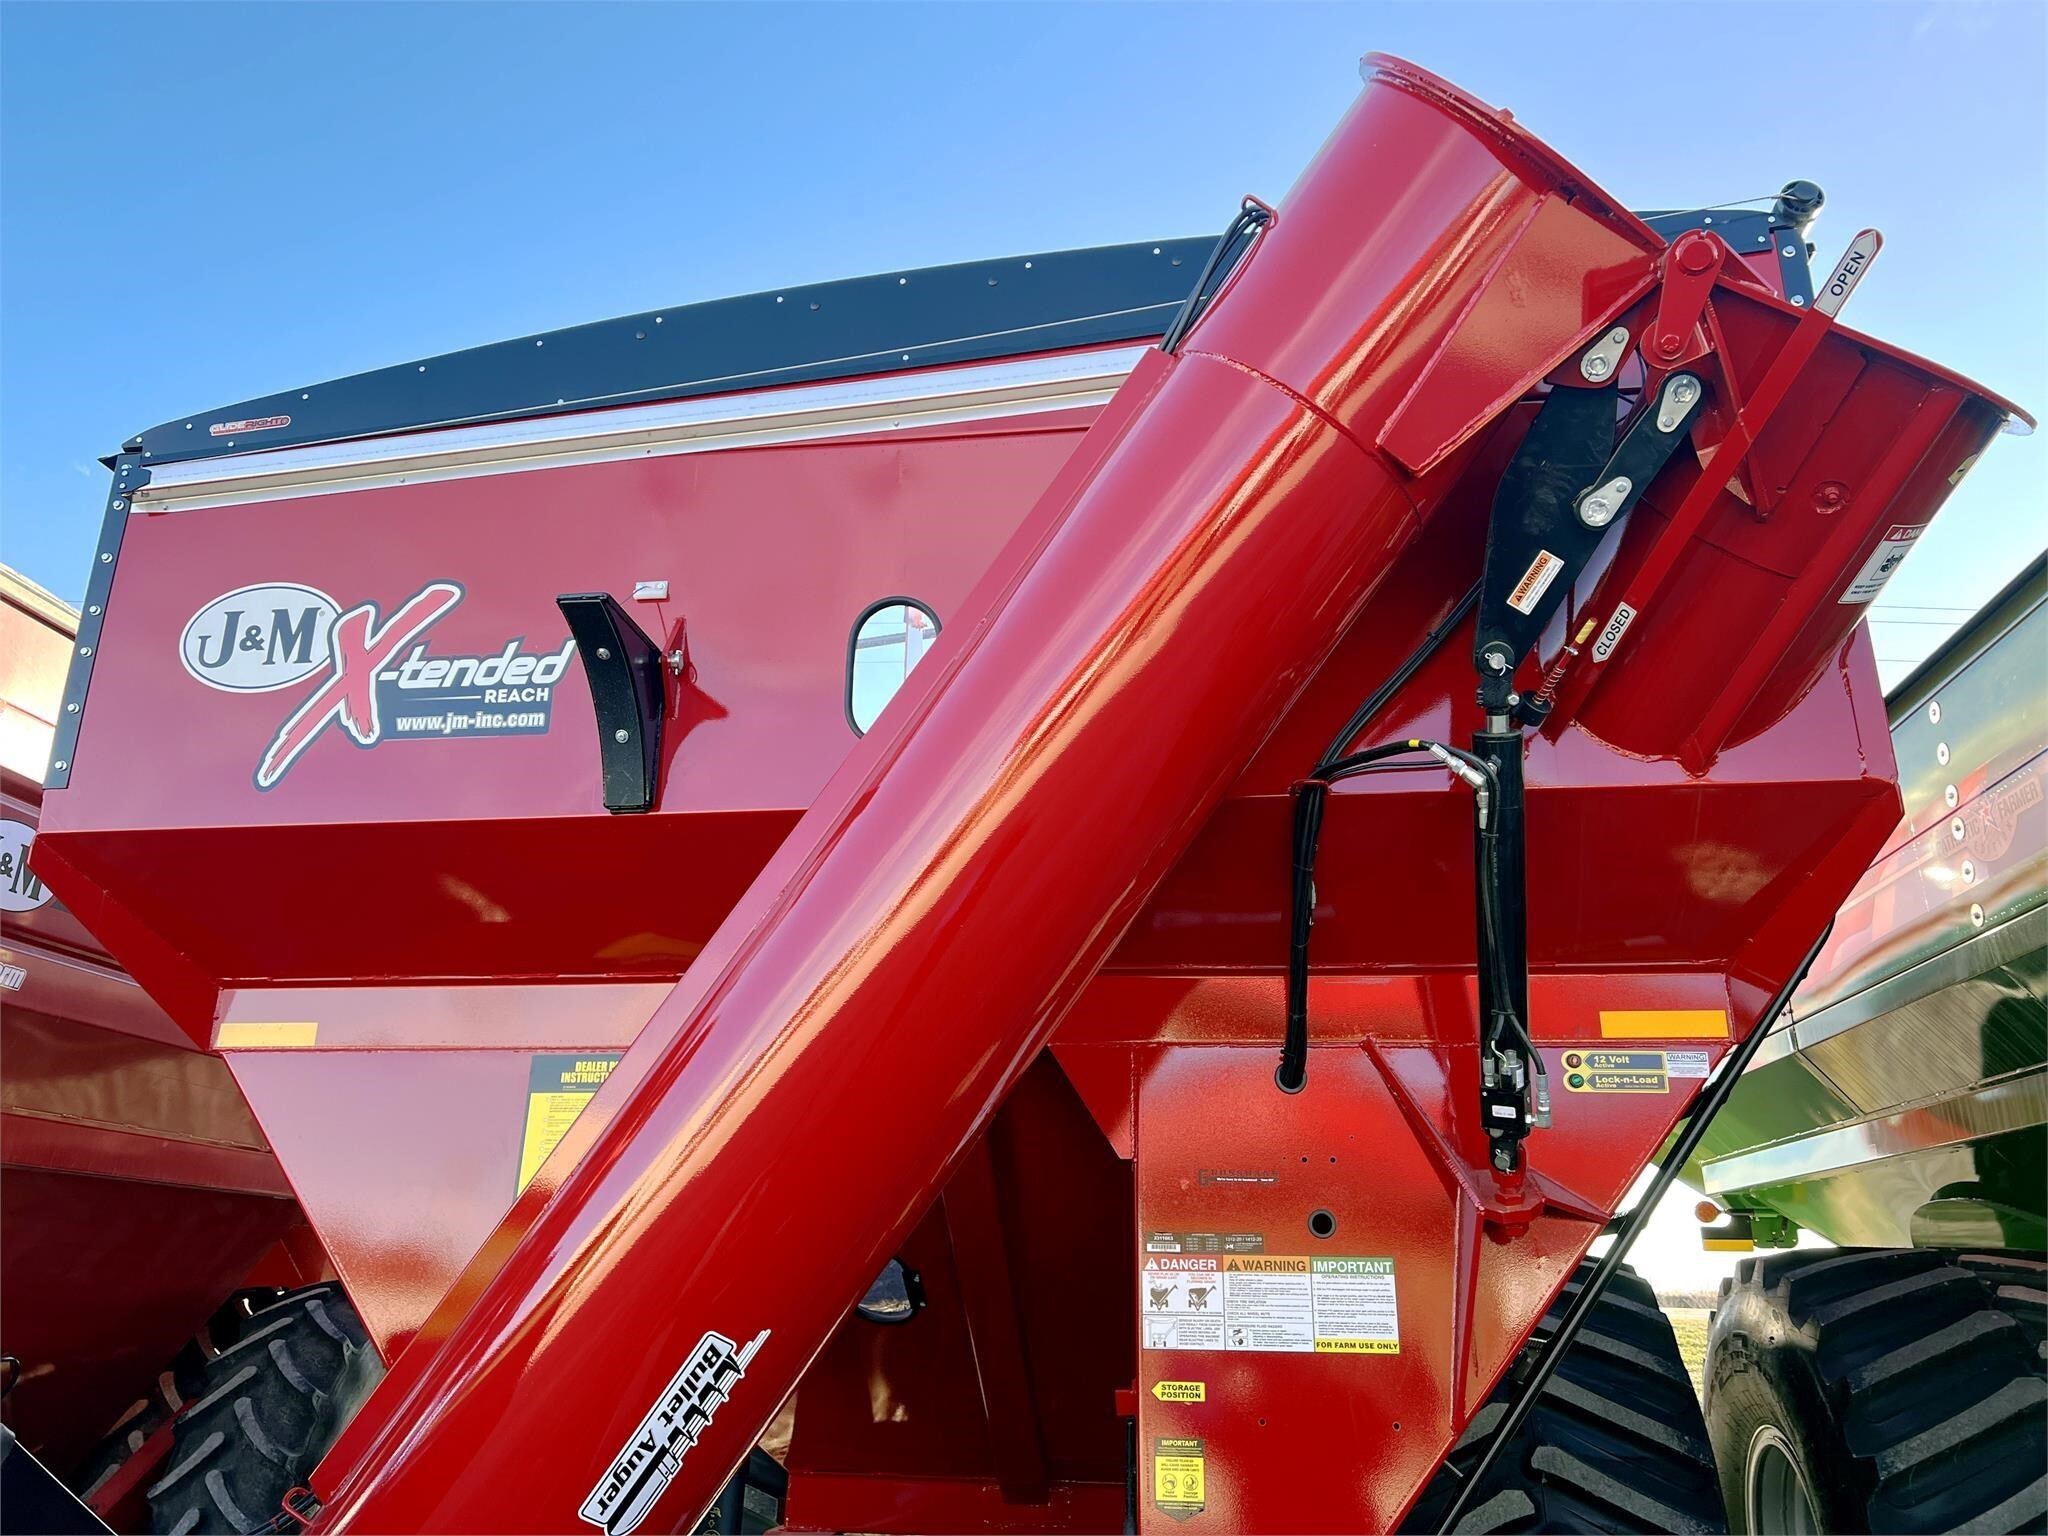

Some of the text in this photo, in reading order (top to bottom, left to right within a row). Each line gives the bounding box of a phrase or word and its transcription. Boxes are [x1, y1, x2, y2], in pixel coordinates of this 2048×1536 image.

[1830, 251, 1866, 297] OPEN
[1519, 557, 1548, 595] WARNING
[197, 607, 322, 668] J&M
[1596, 609, 1630, 656] CLOSED
[484, 687, 550, 703] REACH
[396, 711, 546, 734] www.jm-inc.com
[1997, 781, 2040, 819] FARMER
[0, 835, 41, 901] &M
[575, 1060, 608, 1072] DEALER
[1594, 1056, 1630, 1064] 12 Volt
[1595, 1075, 1659, 1084] Lock-n-Load
[1160, 1258, 1217, 1271] DANGER
[1242, 1260, 1306, 1272] WARNING
[1313, 1261, 1393, 1274] IMPORTANT
[1316, 1341, 1399, 1351] FOR FARM USE ONLY
[1161, 1384, 1201, 1392] STORAGE
[1161, 1391, 1201, 1399] POSITION
[597, 1343, 723, 1516] Bullet Auger
[1161, 1440, 1198, 1448] IMPORTANT
